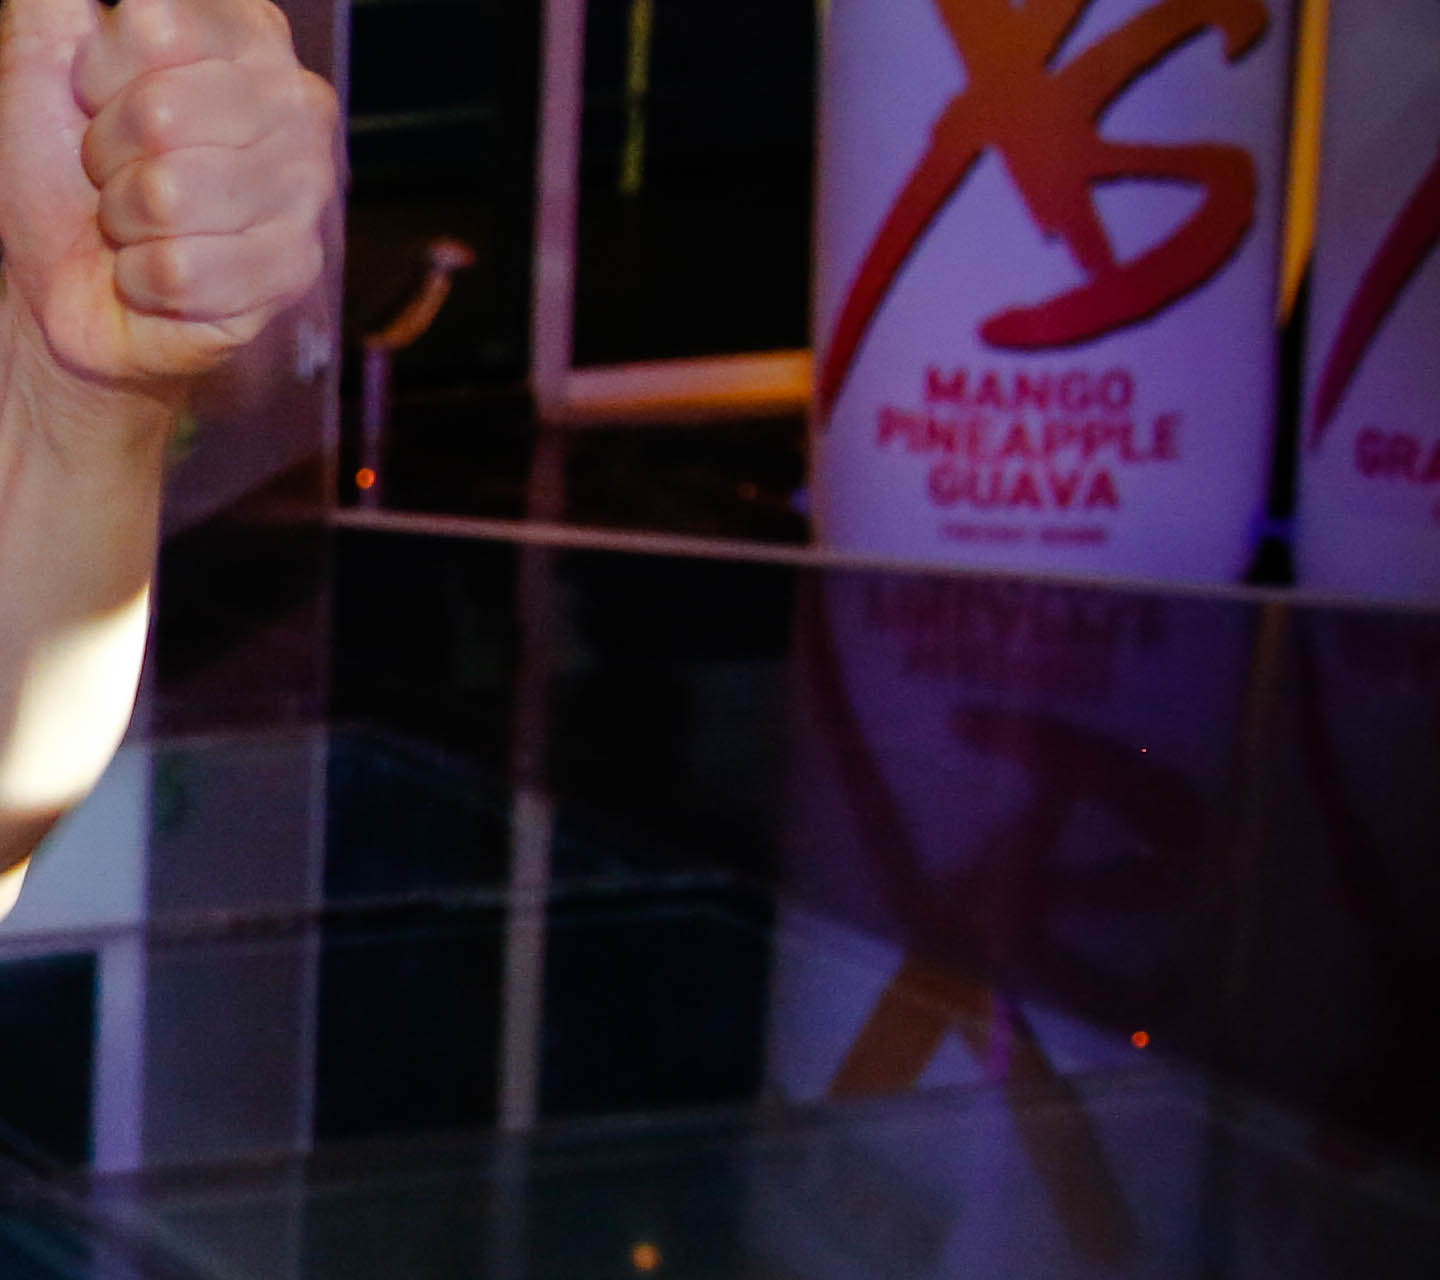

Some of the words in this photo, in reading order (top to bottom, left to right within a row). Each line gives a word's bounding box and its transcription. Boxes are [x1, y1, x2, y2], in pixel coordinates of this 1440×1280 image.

[925, 366, 1135, 410] MANGO
[876, 406, 1183, 462] PINEAPPLE
[928, 458, 1120, 509] GUAVA
